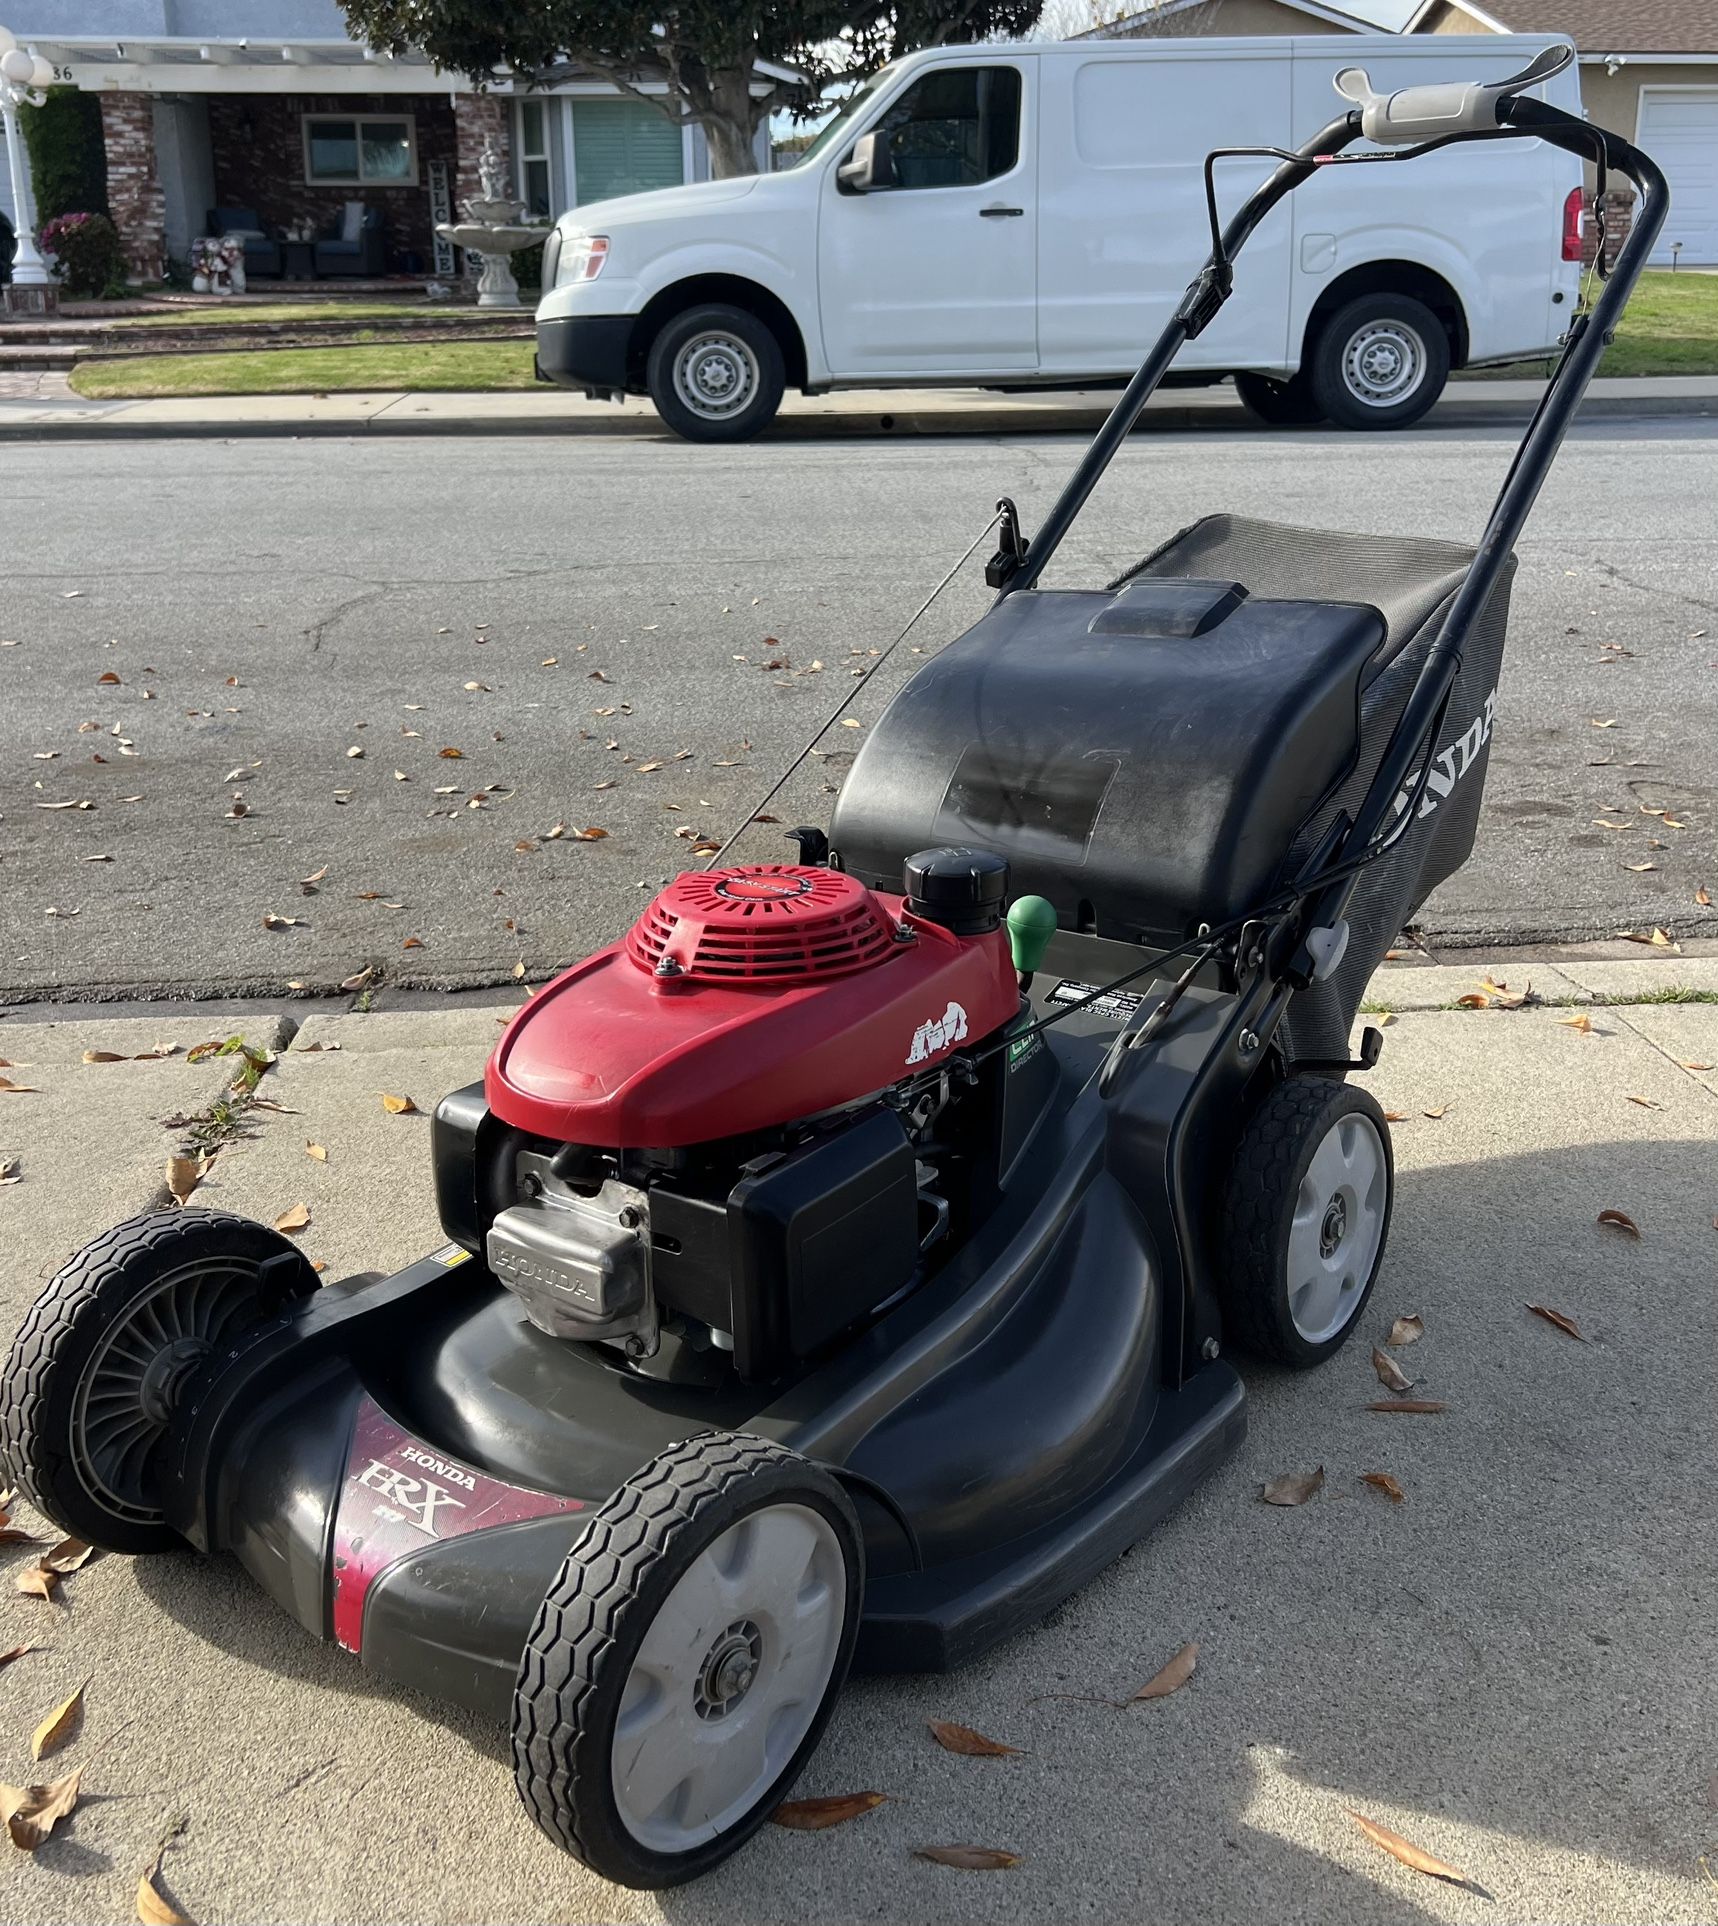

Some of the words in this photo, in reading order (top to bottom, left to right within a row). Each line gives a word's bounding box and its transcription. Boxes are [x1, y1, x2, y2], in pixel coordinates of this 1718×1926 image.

[494, 1246, 596, 1302] HONDA
[399, 1446, 477, 1492] HONDA
[351, 1459, 466, 1539] HRX
